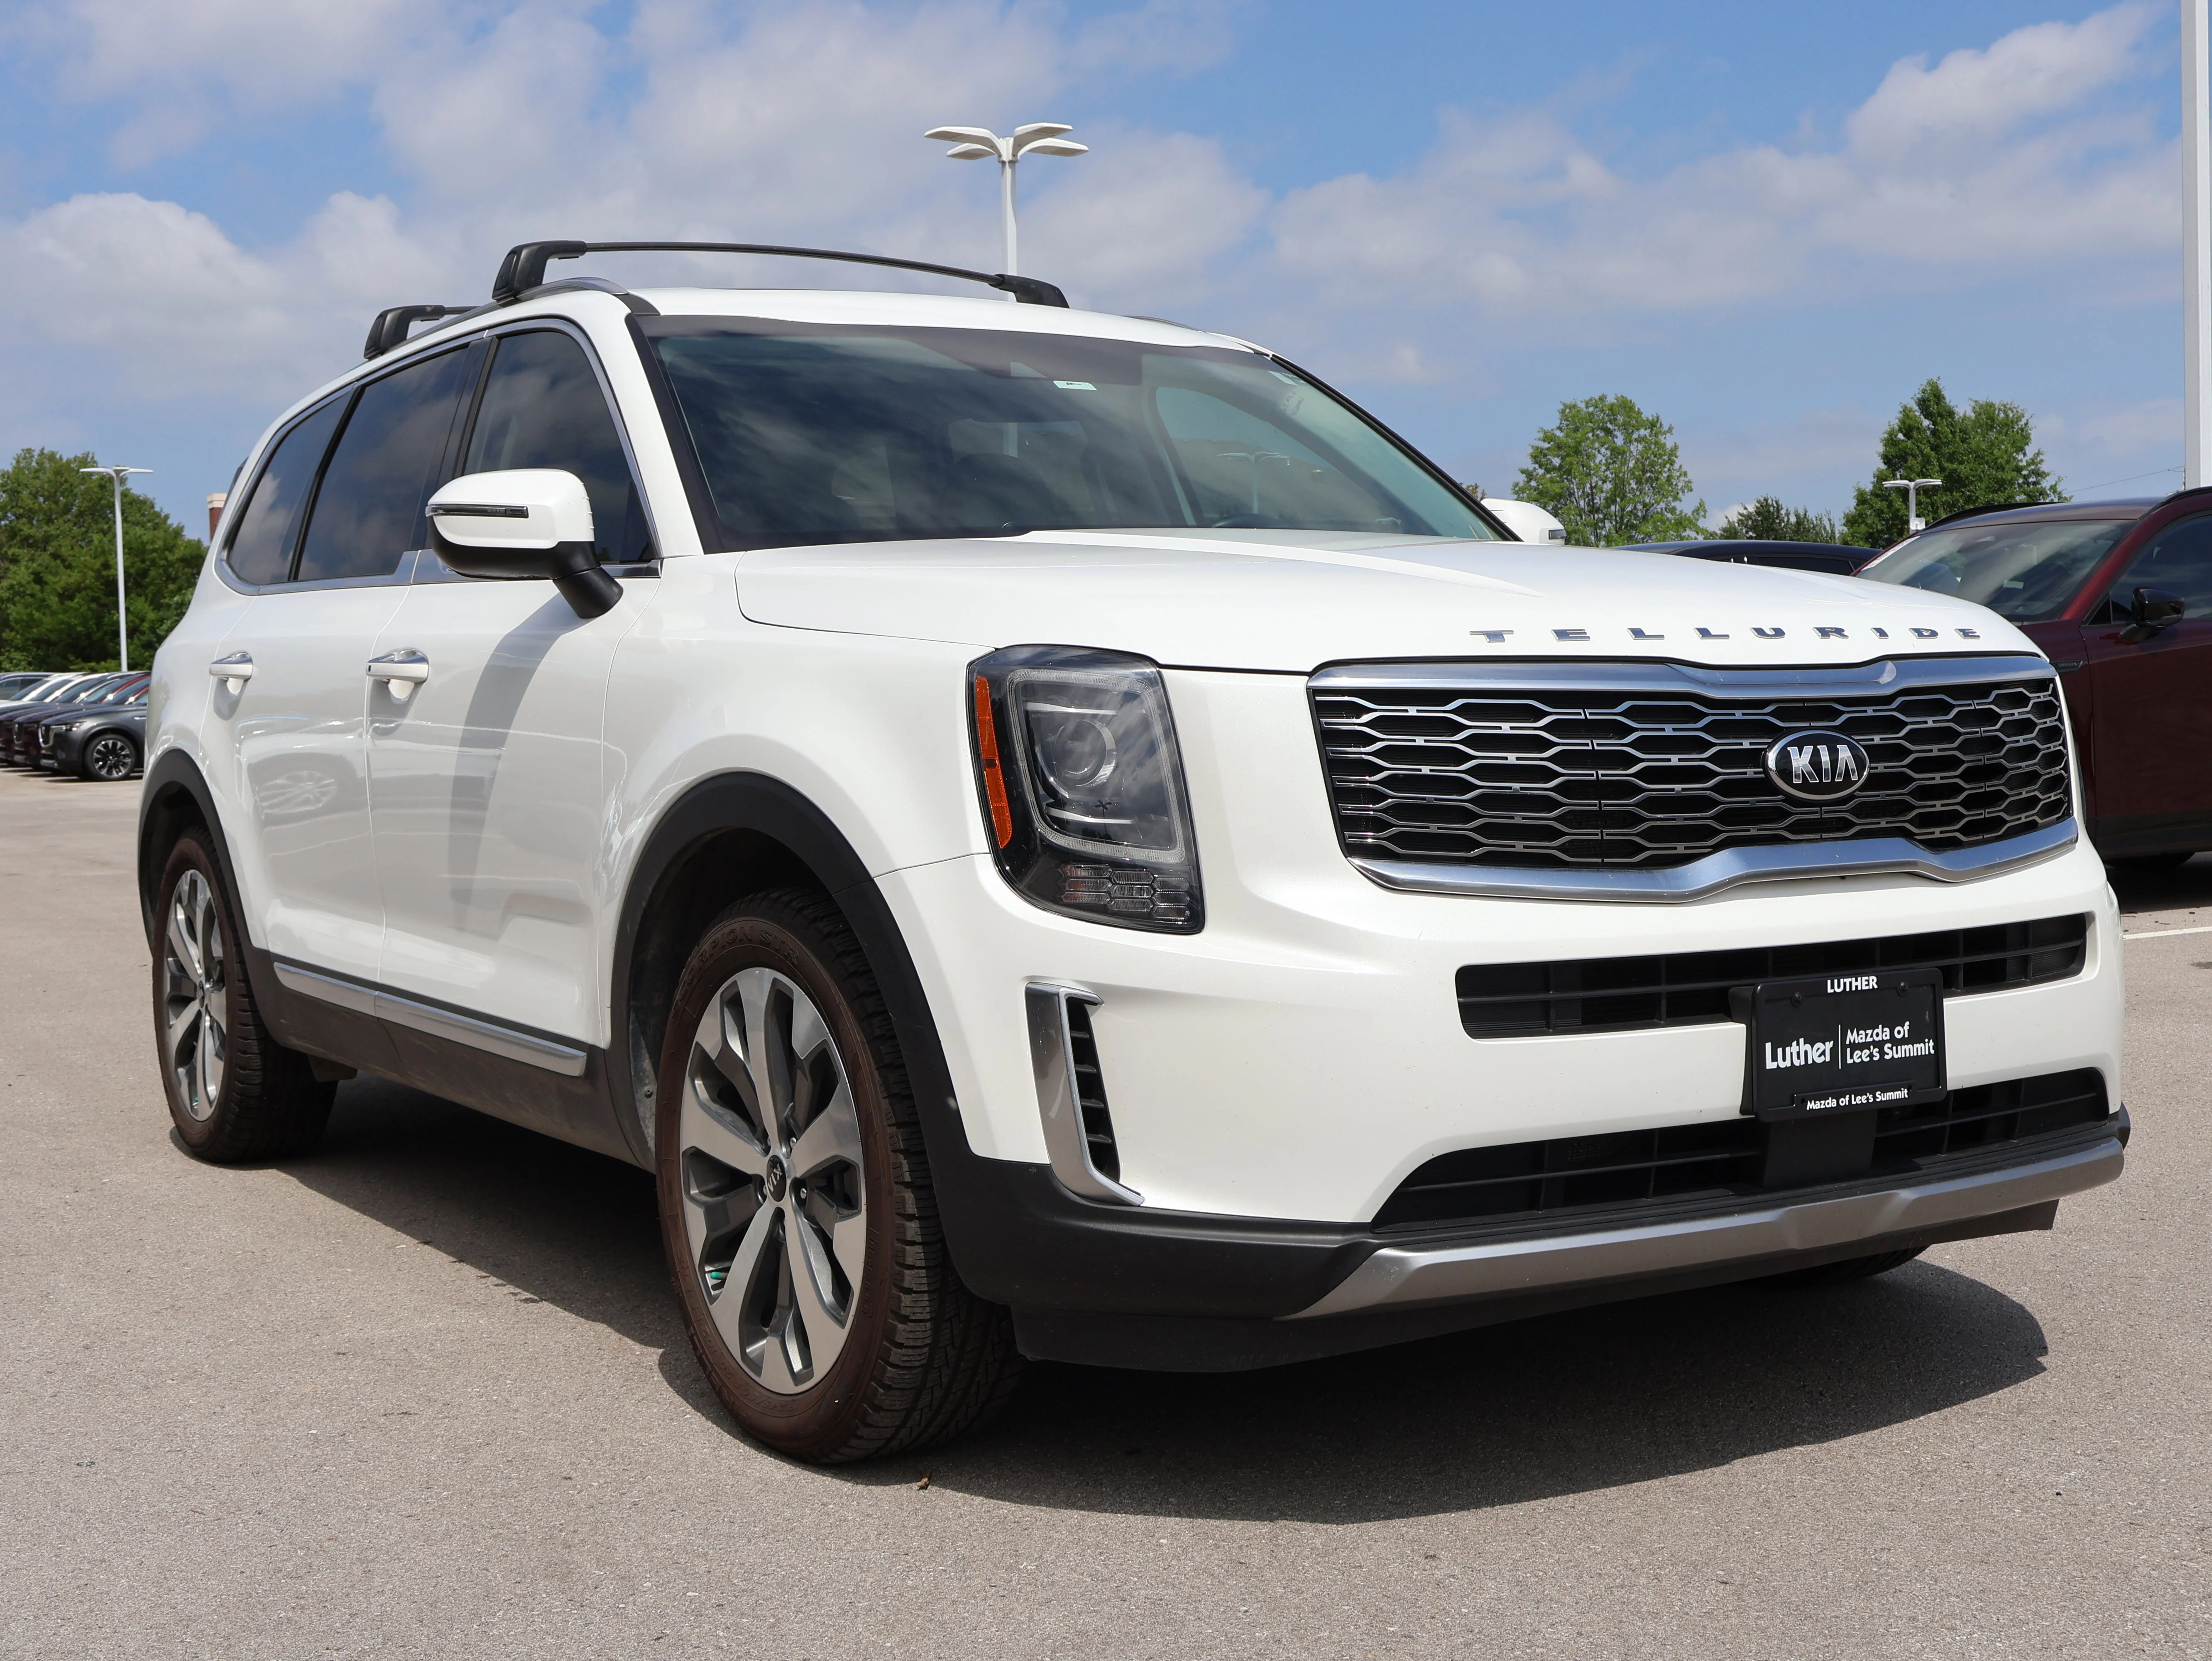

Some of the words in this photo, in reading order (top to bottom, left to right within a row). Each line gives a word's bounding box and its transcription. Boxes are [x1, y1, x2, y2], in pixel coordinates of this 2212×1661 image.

[1469, 626, 1981, 643] TELLURIDE
[1787, 745, 1859, 784] KIA
[671, 926, 755, 1023] SCORPION
[759, 928, 800, 965] STR
[1827, 976, 1878, 993] LUTHER
[1845, 1024, 1890, 1044] Mazda
[1894, 1021, 1910, 1039] of
[1765, 1037, 1834, 1069] Luther
[1847, 1045, 1880, 1064] Lee's
[1884, 1039, 1935, 1059] Summit
[1806, 1097, 1837, 1110] Mazda
[1839, 1094, 1850, 1106] of
[1851, 1093, 1874, 1105] Lee's
[1876, 1088, 1908, 1102] Summit
[768, 1163, 783, 1193] KIA
